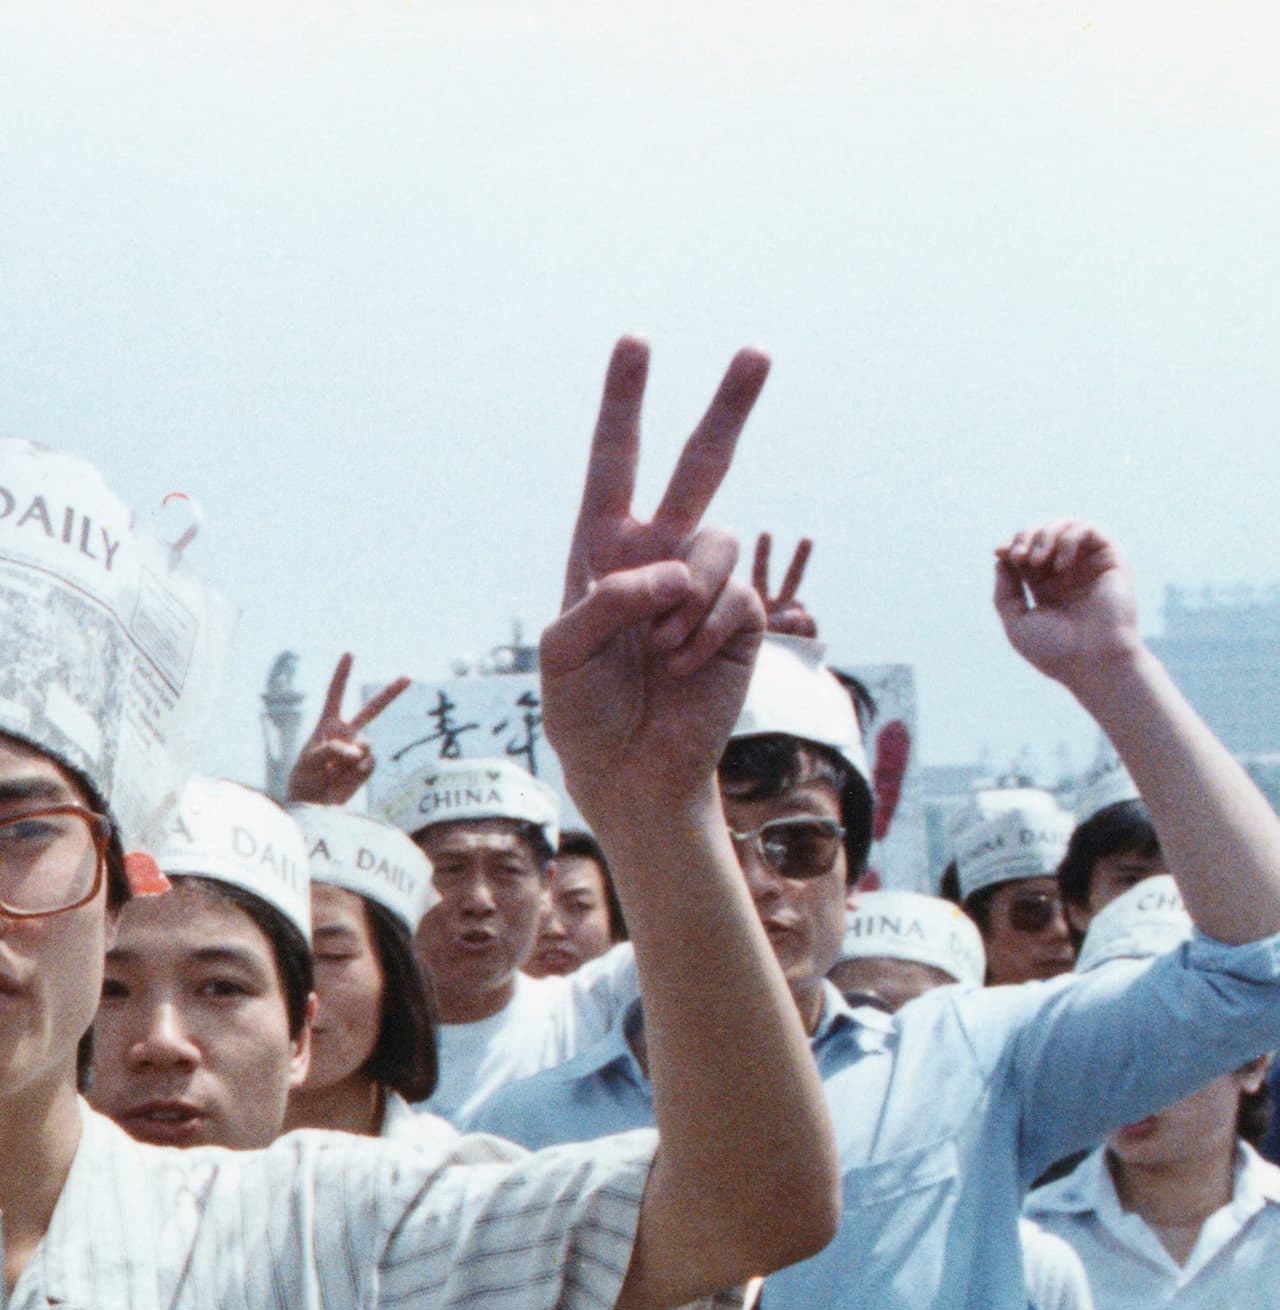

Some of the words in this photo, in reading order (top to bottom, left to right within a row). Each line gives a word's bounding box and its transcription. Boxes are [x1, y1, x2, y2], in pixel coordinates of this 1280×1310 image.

[418, 788, 503, 814] CHINA
[232, 825, 304, 898] DAIL
[356, 847, 416, 893] DAILY
[845, 914, 927, 943] HINA
